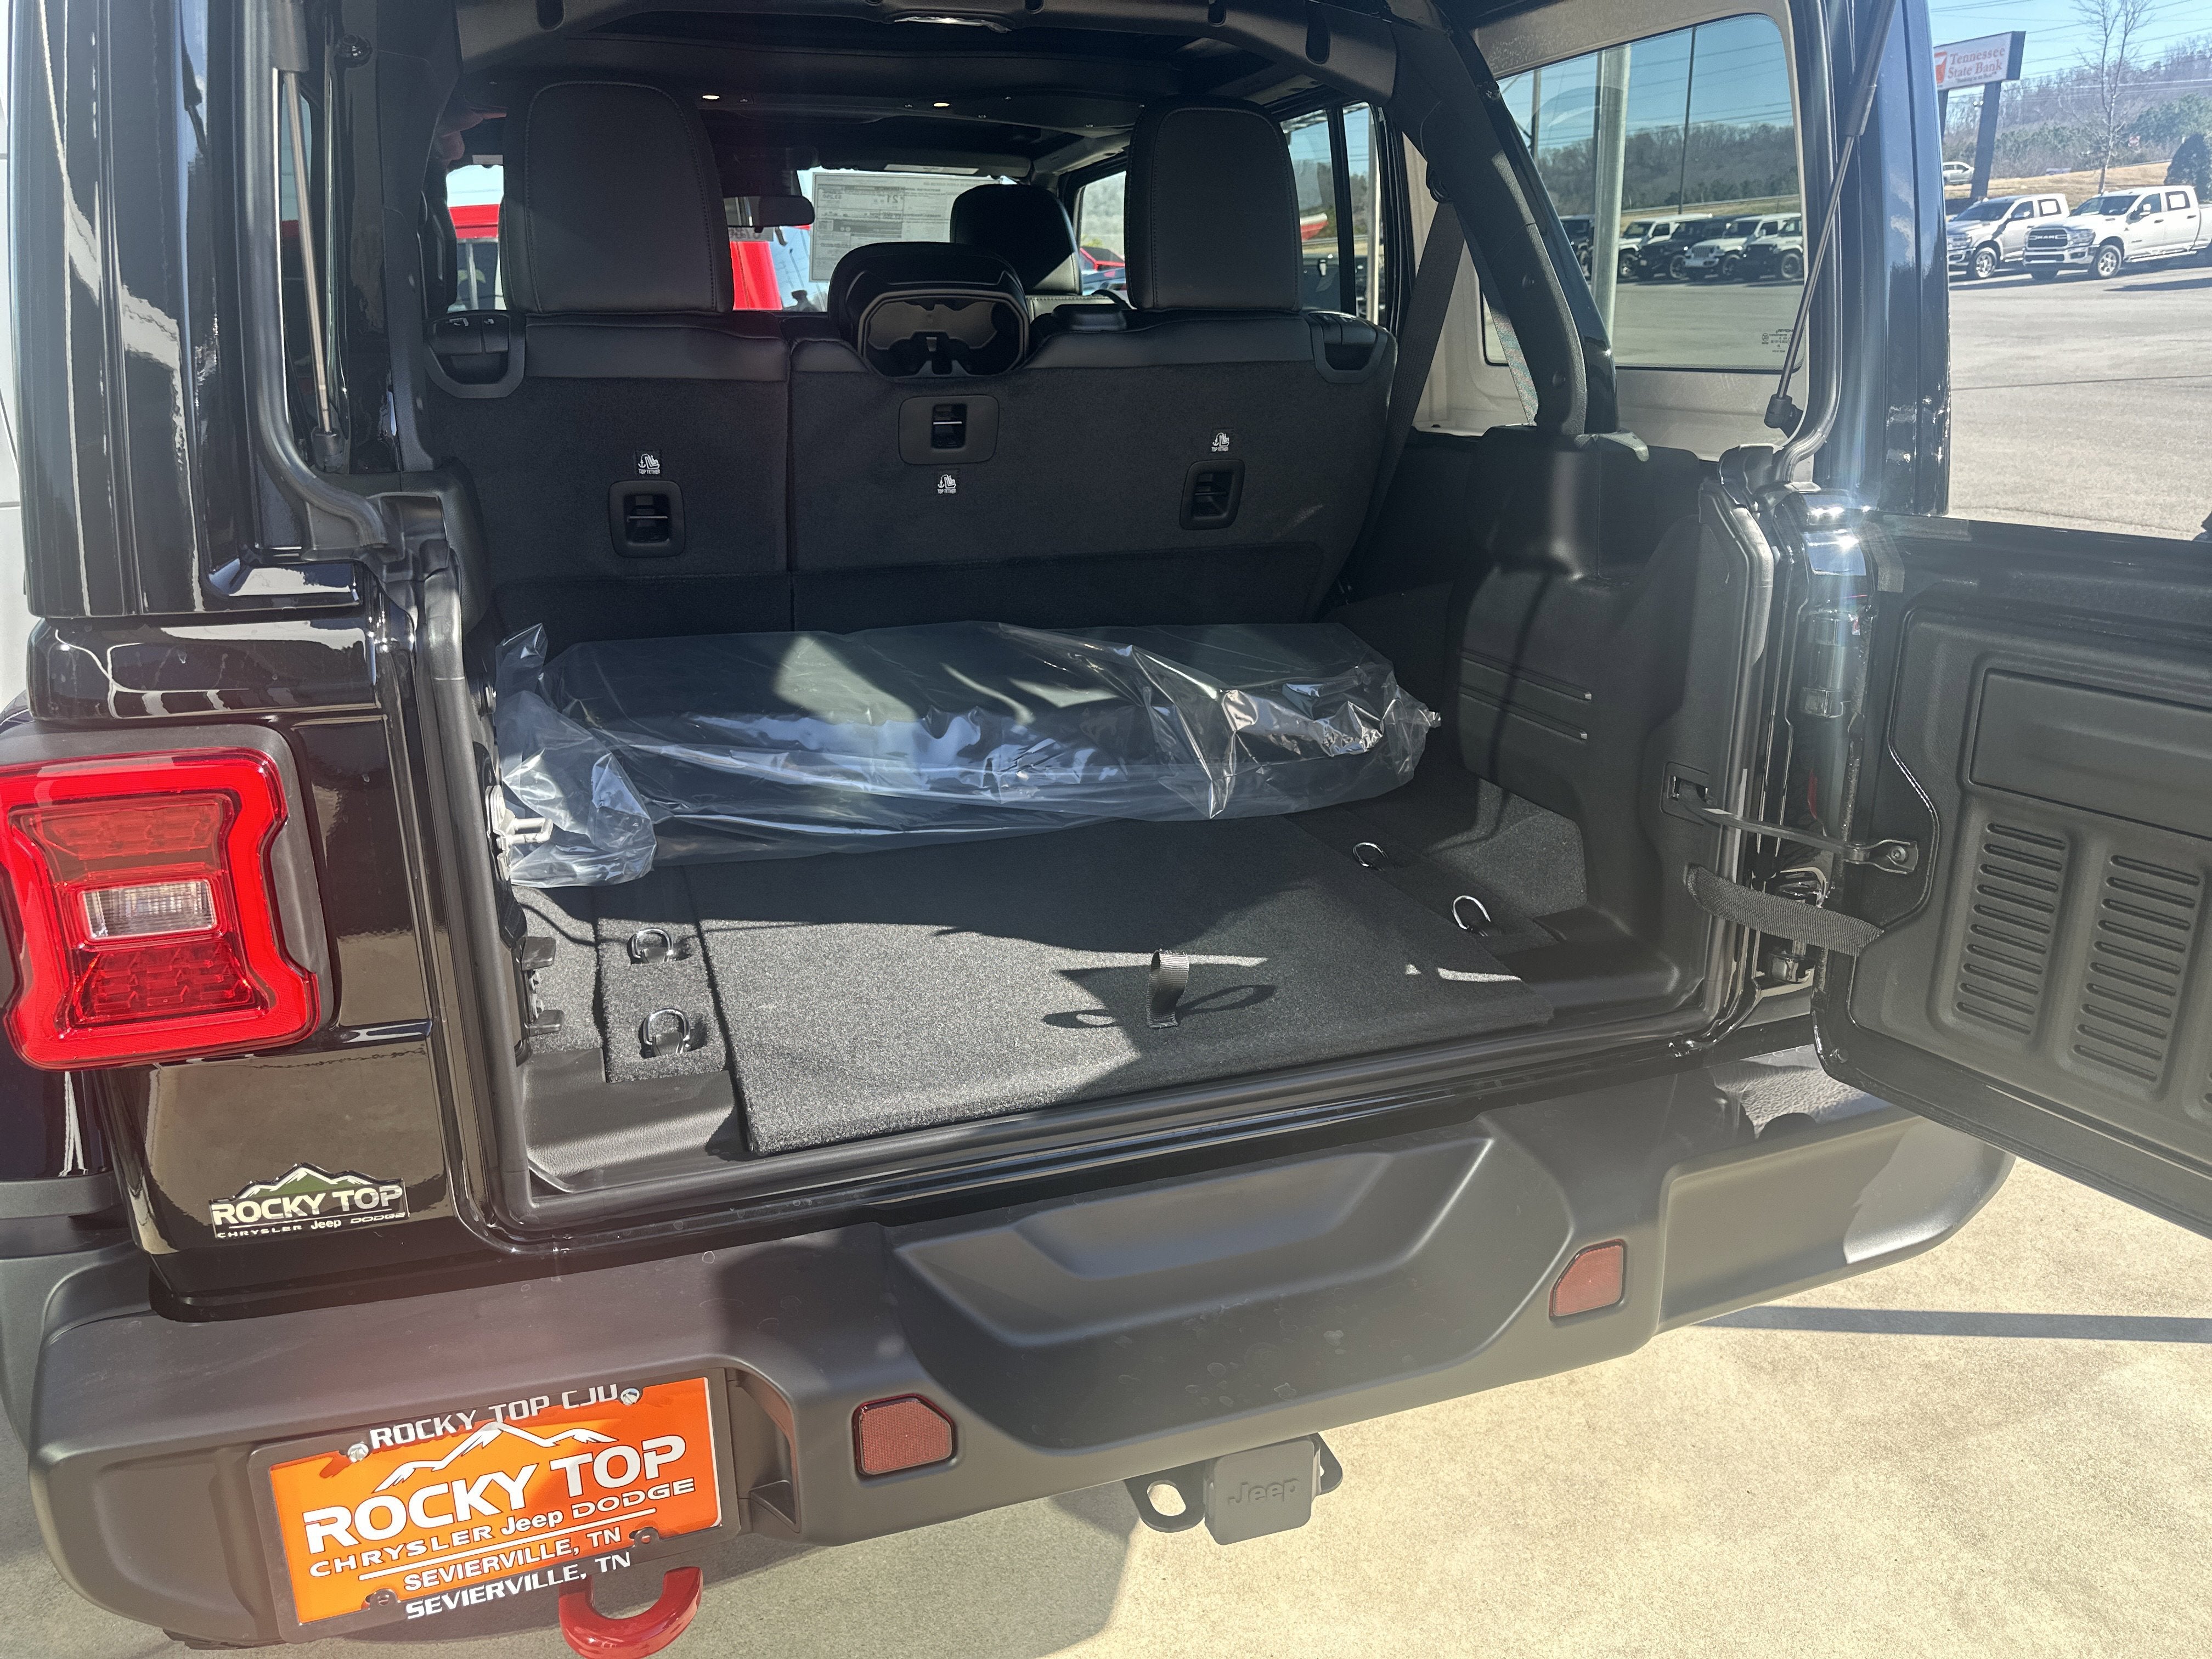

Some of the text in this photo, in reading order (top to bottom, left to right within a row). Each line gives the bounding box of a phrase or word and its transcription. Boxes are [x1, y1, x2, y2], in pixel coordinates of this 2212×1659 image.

[1948, 64, 1973, 79] State
[1974, 59, 2002, 75] Bank
[1950, 47, 2006, 65] Tennessee
[211, 1185, 403, 1226] ROCKY TOP
[217, 1212, 406, 1238] CHRYSLER Jeep DODGE
[370, 1409, 476, 1450] ROCKY
[489, 1394, 550, 1422] TOP
[303, 1434, 687, 1555] ROCKY TOP
[1227, 1478, 1300, 1506] Jeep
[309, 1477, 695, 1578] CHRYSLER Jeep DODGE
[403, 1527, 622, 1592] SEVIERVILLE, TN
[405, 1550, 631, 1620] SEVIERVILLE, TN
